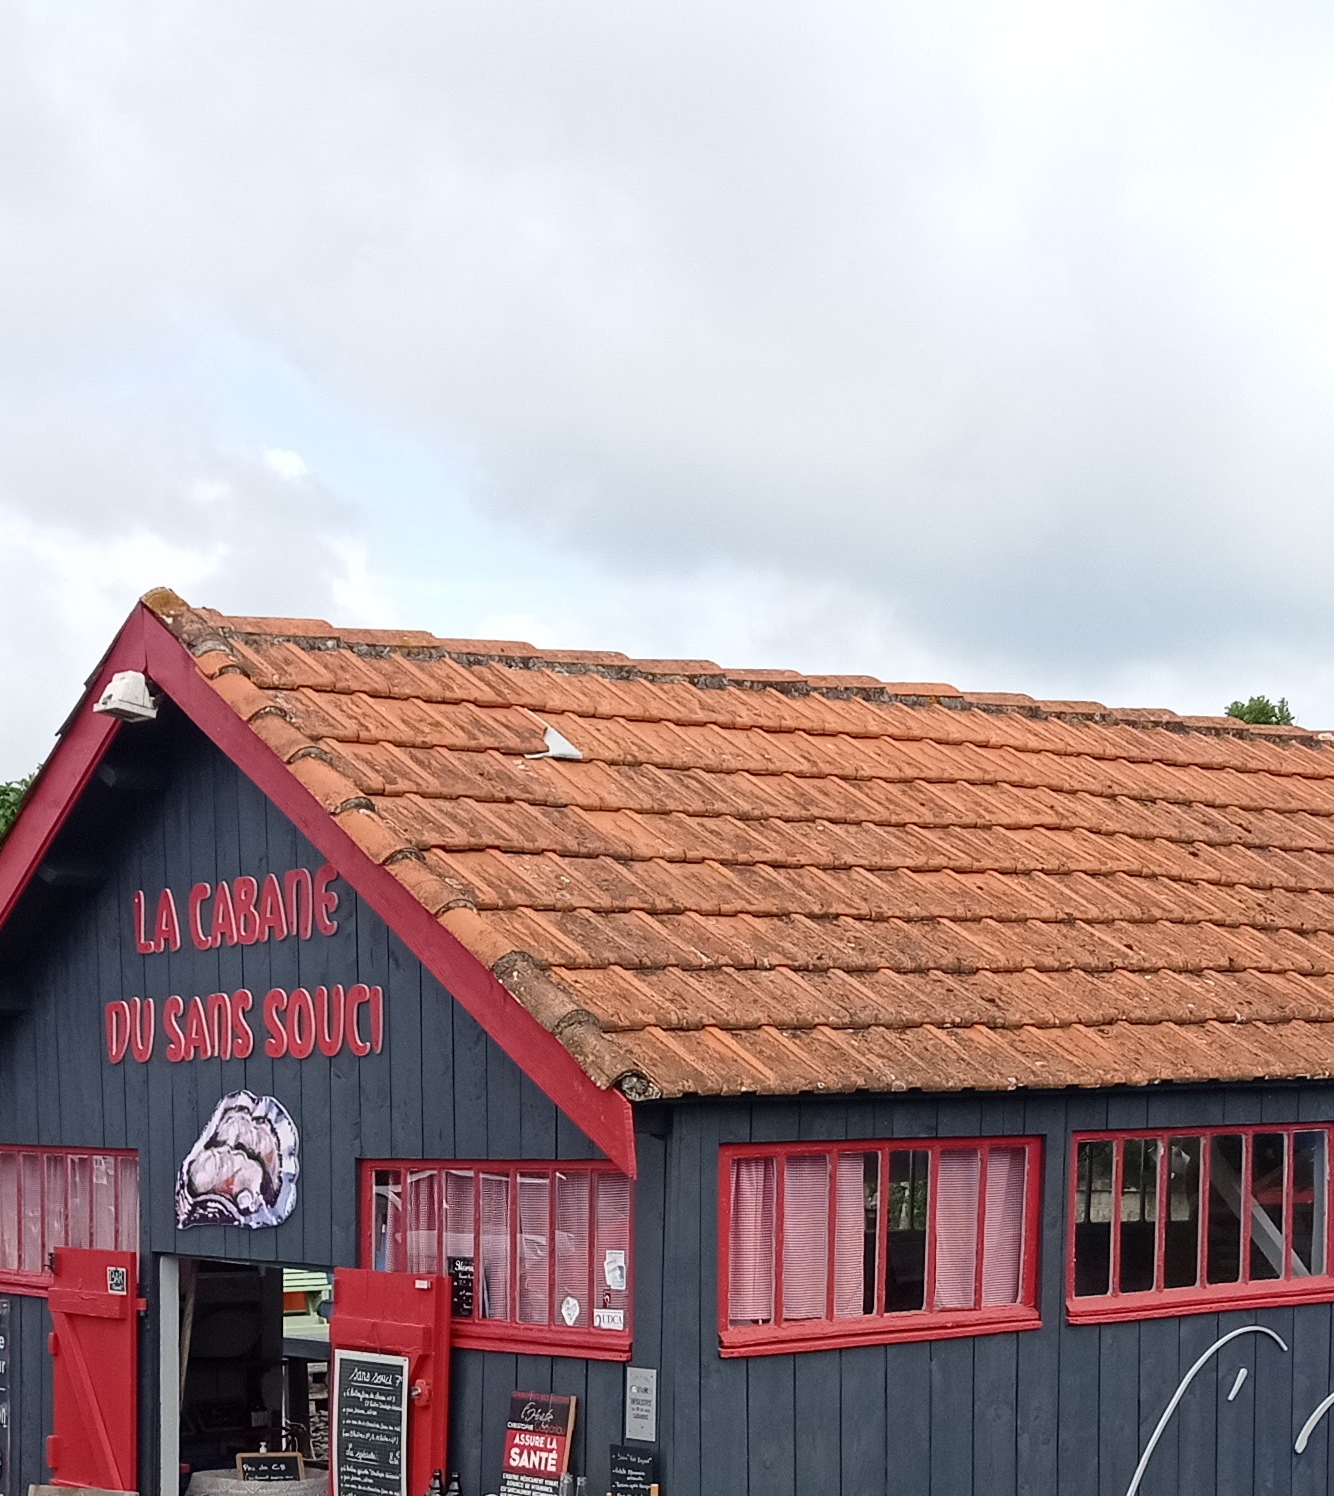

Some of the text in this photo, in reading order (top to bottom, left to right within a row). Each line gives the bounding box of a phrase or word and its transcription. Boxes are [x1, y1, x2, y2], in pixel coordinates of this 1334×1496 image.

[133, 863, 339, 954] LA CABANE
[105, 984, 383, 1063] DU SANS SOUCI
[509, 1447, 558, 1472] SANTÉ
[514, 1432, 558, 1449] ASSURE LA
